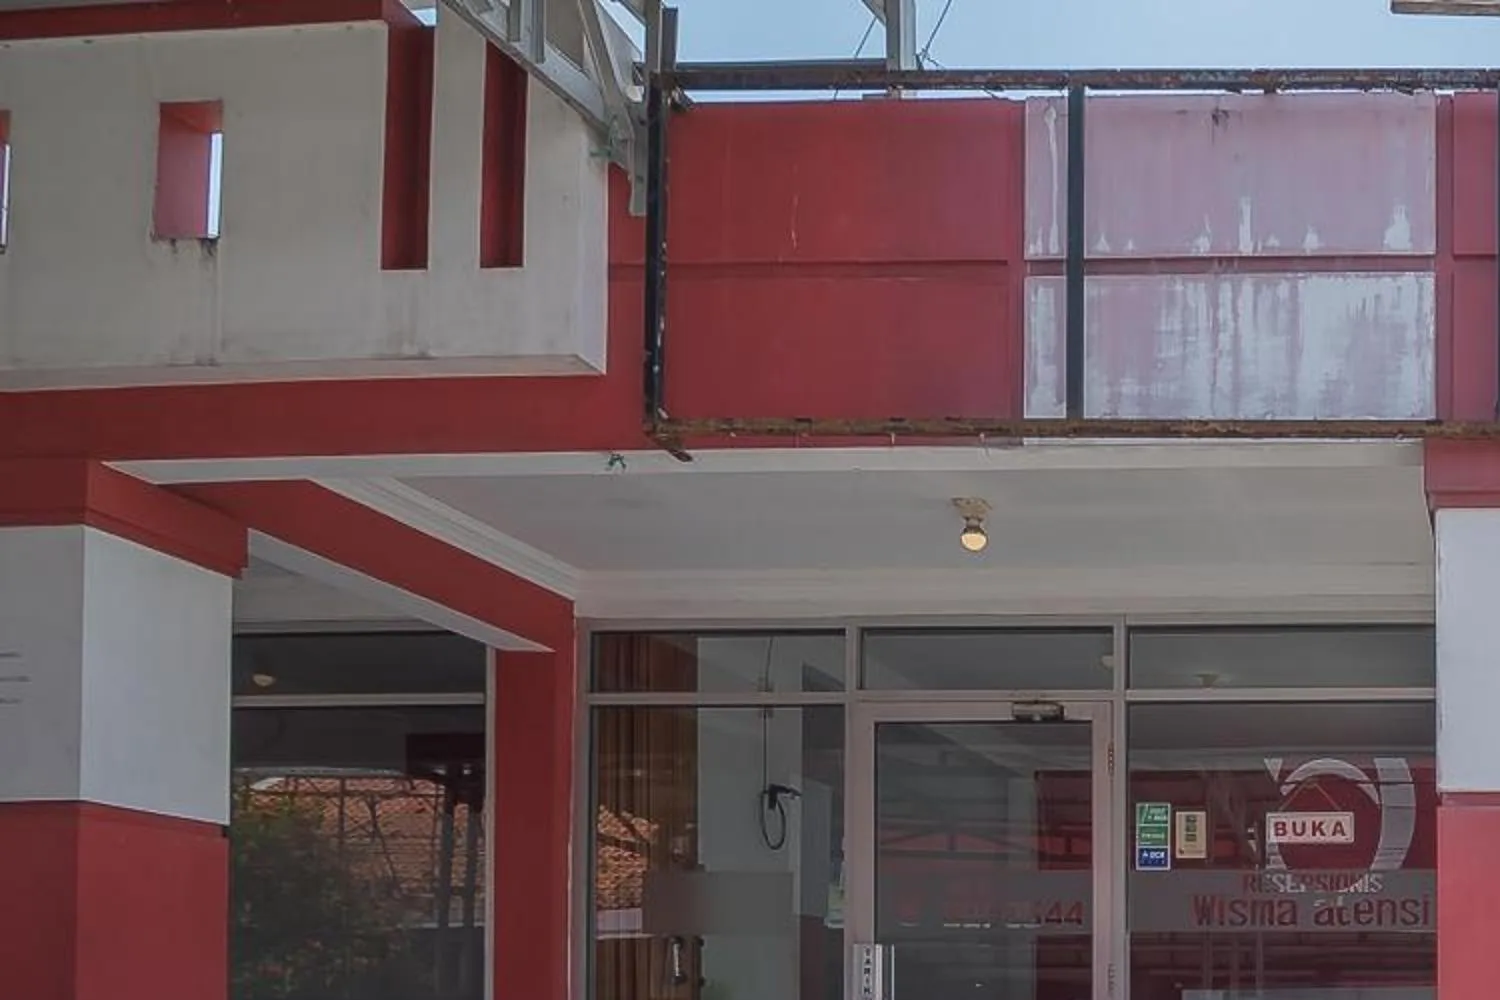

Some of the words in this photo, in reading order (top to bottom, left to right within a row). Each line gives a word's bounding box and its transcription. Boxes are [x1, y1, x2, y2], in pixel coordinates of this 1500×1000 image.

[1273, 821, 1347, 837] BUKA
[1193, 896, 1297, 926] Wisma
[1313, 894, 1430, 927] atensi
